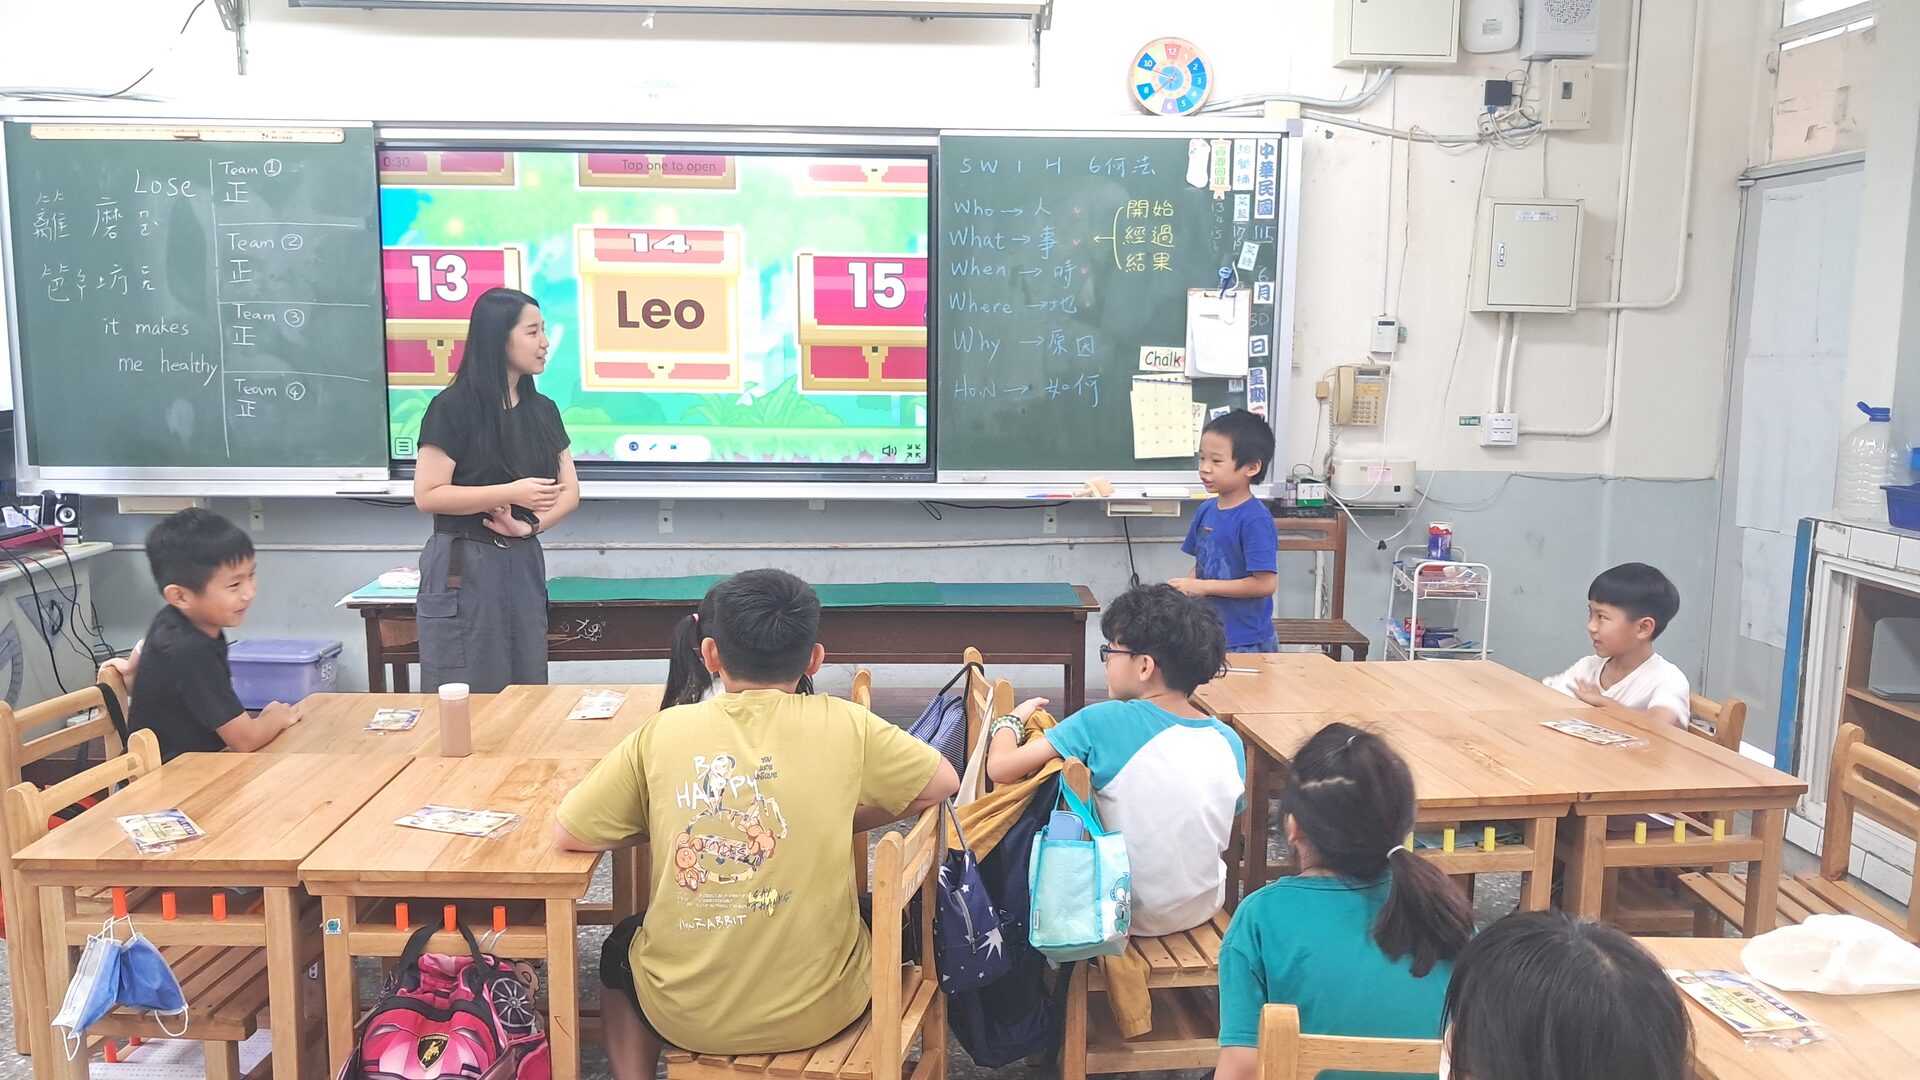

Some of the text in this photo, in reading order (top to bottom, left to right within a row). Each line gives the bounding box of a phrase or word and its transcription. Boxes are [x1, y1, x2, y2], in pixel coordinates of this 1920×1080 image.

[218, 161, 258, 175] Team
[383, 156, 410, 168] 0:30
[622, 159, 716, 173] Tap one to open
[135, 169, 197, 198] Lose
[1257, 142, 1275, 216] 中華民國
[223, 181, 249, 202] 正
[954, 197, 1052, 217] Who 人
[1126, 199, 1174, 219] 開始
[226, 232, 275, 250] Team
[628, 232, 692, 254] 14
[950, 225, 1058, 260] What 事
[1122, 224, 1175, 249] 經過
[229, 259, 252, 283] 正
[951, 256, 1078, 289] When 時
[1124, 252, 1174, 273] 結果
[411, 254, 469, 302] 13
[848, 261, 906, 309] 15
[950, 290, 1078, 315] Where 地
[1257, 283, 1271, 301] 月
[234, 303, 276, 323] Team
[617, 291, 705, 329] Leo
[103, 315, 189, 336] it makes
[233, 325, 255, 346] 正
[953, 326, 1094, 363] Why 原因
[1251, 338, 1266, 355] 日
[118, 348, 218, 387] me healthy
[1145, 351, 1181, 367] Chalk
[234, 379, 277, 397] Team
[1045, 374, 1100, 408] 如何
[236, 400, 256, 418] 正
